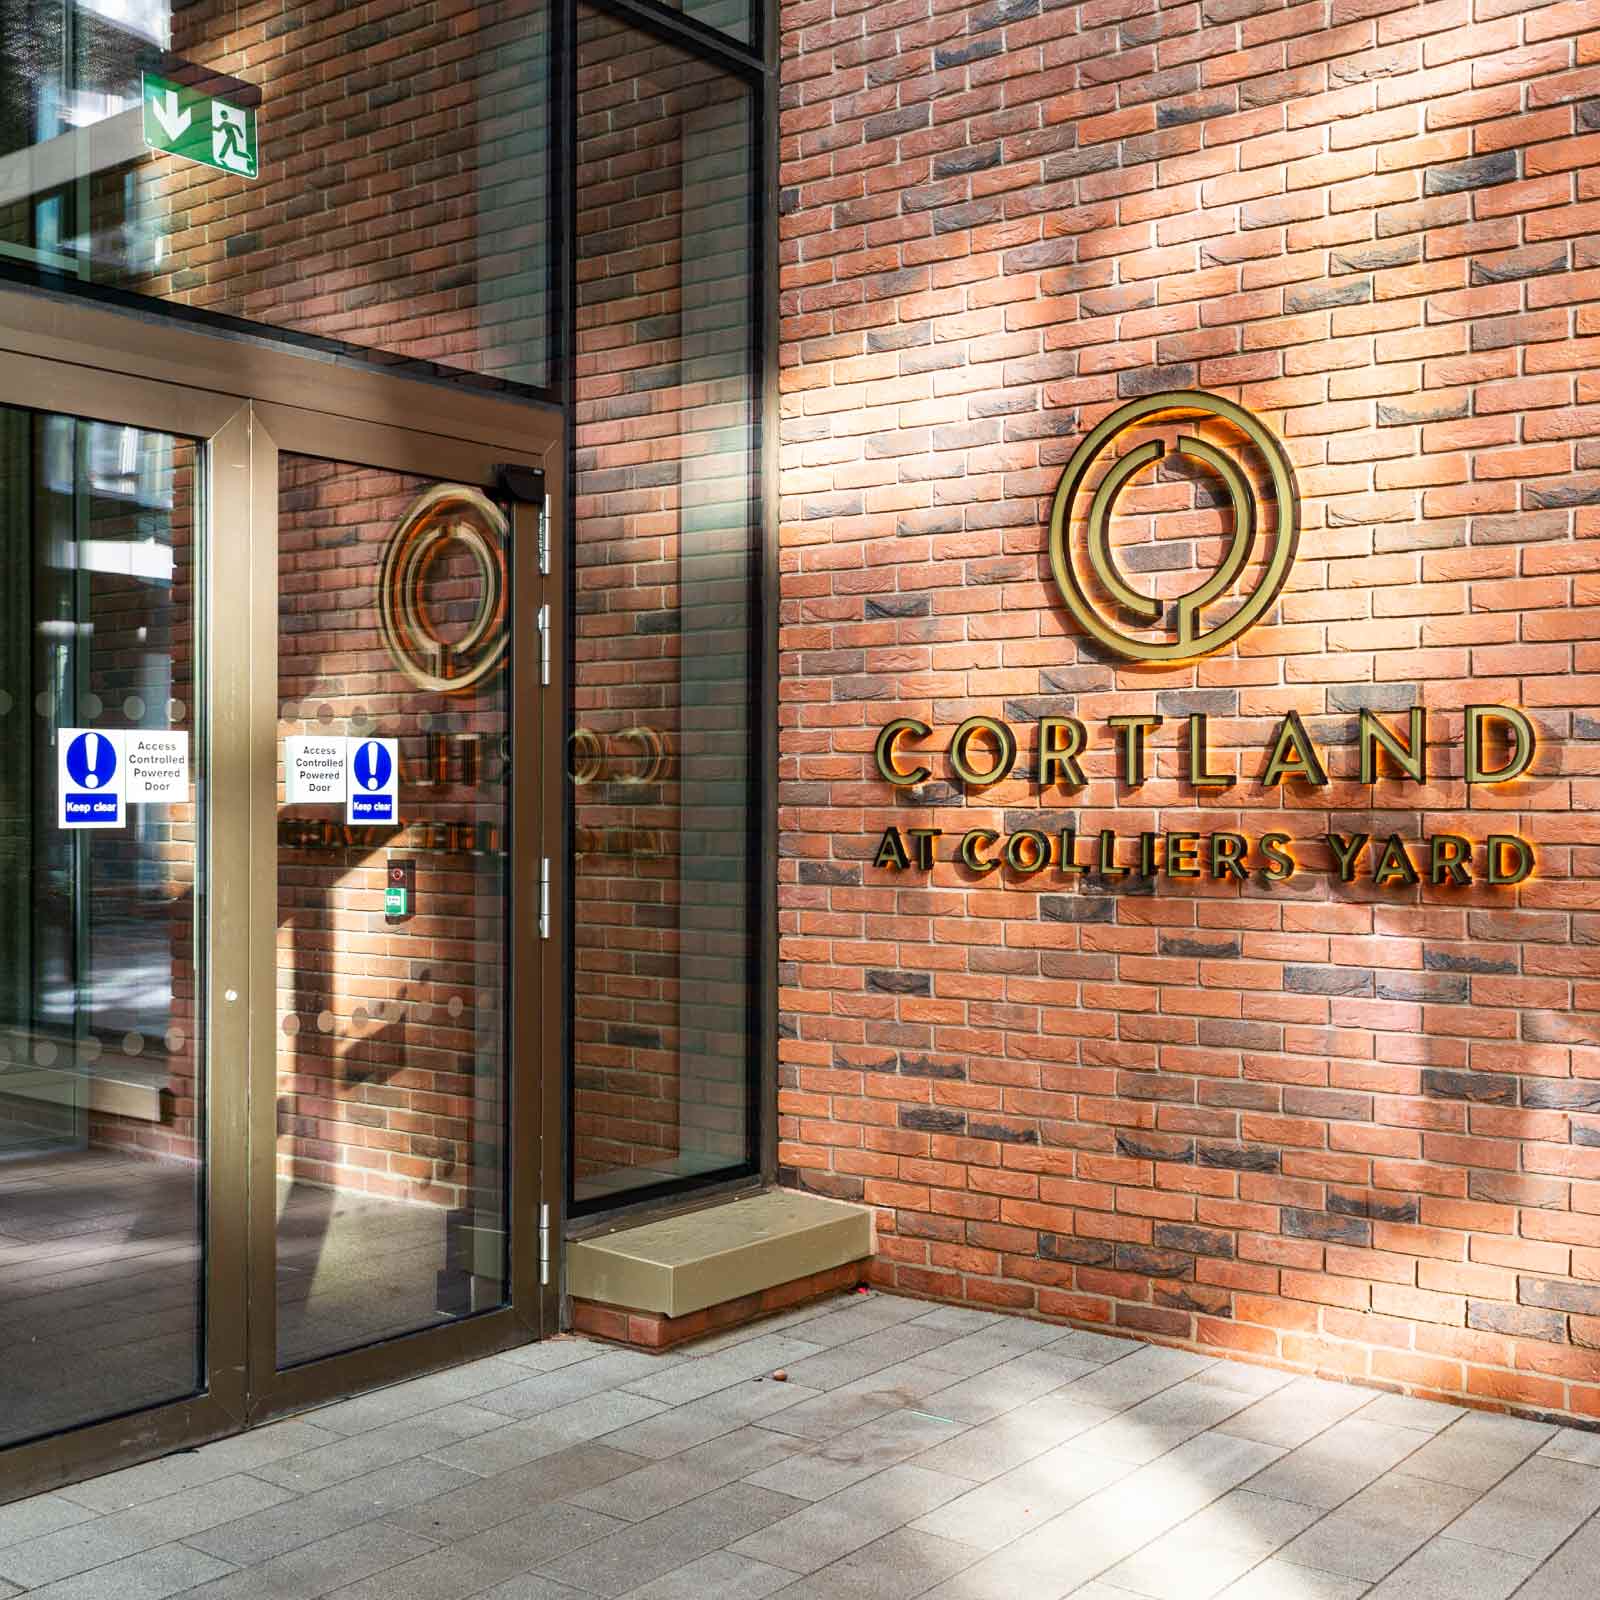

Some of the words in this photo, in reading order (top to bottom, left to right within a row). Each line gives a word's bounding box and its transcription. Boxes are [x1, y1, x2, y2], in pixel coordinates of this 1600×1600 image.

[137, 741, 177, 751] Access
[303, 746, 337, 755] Access
[875, 704, 1536, 787] CORTLAND
[128, 754, 185, 765] Controlled
[296, 758, 344, 768] Controlled
[134, 768, 181, 778] Powered
[300, 771, 340, 780] Powered
[144, 782, 171, 791] Door
[309, 784, 331, 792] Door
[66, 802, 91, 813] Keep
[93, 802, 117, 812] clear
[353, 801, 372, 812] Keep
[373, 801, 392, 811] clear
[872, 826, 943, 872] AT
[961, 828, 1296, 881] COLLIERS
[1327, 833, 1536, 885] YARD
